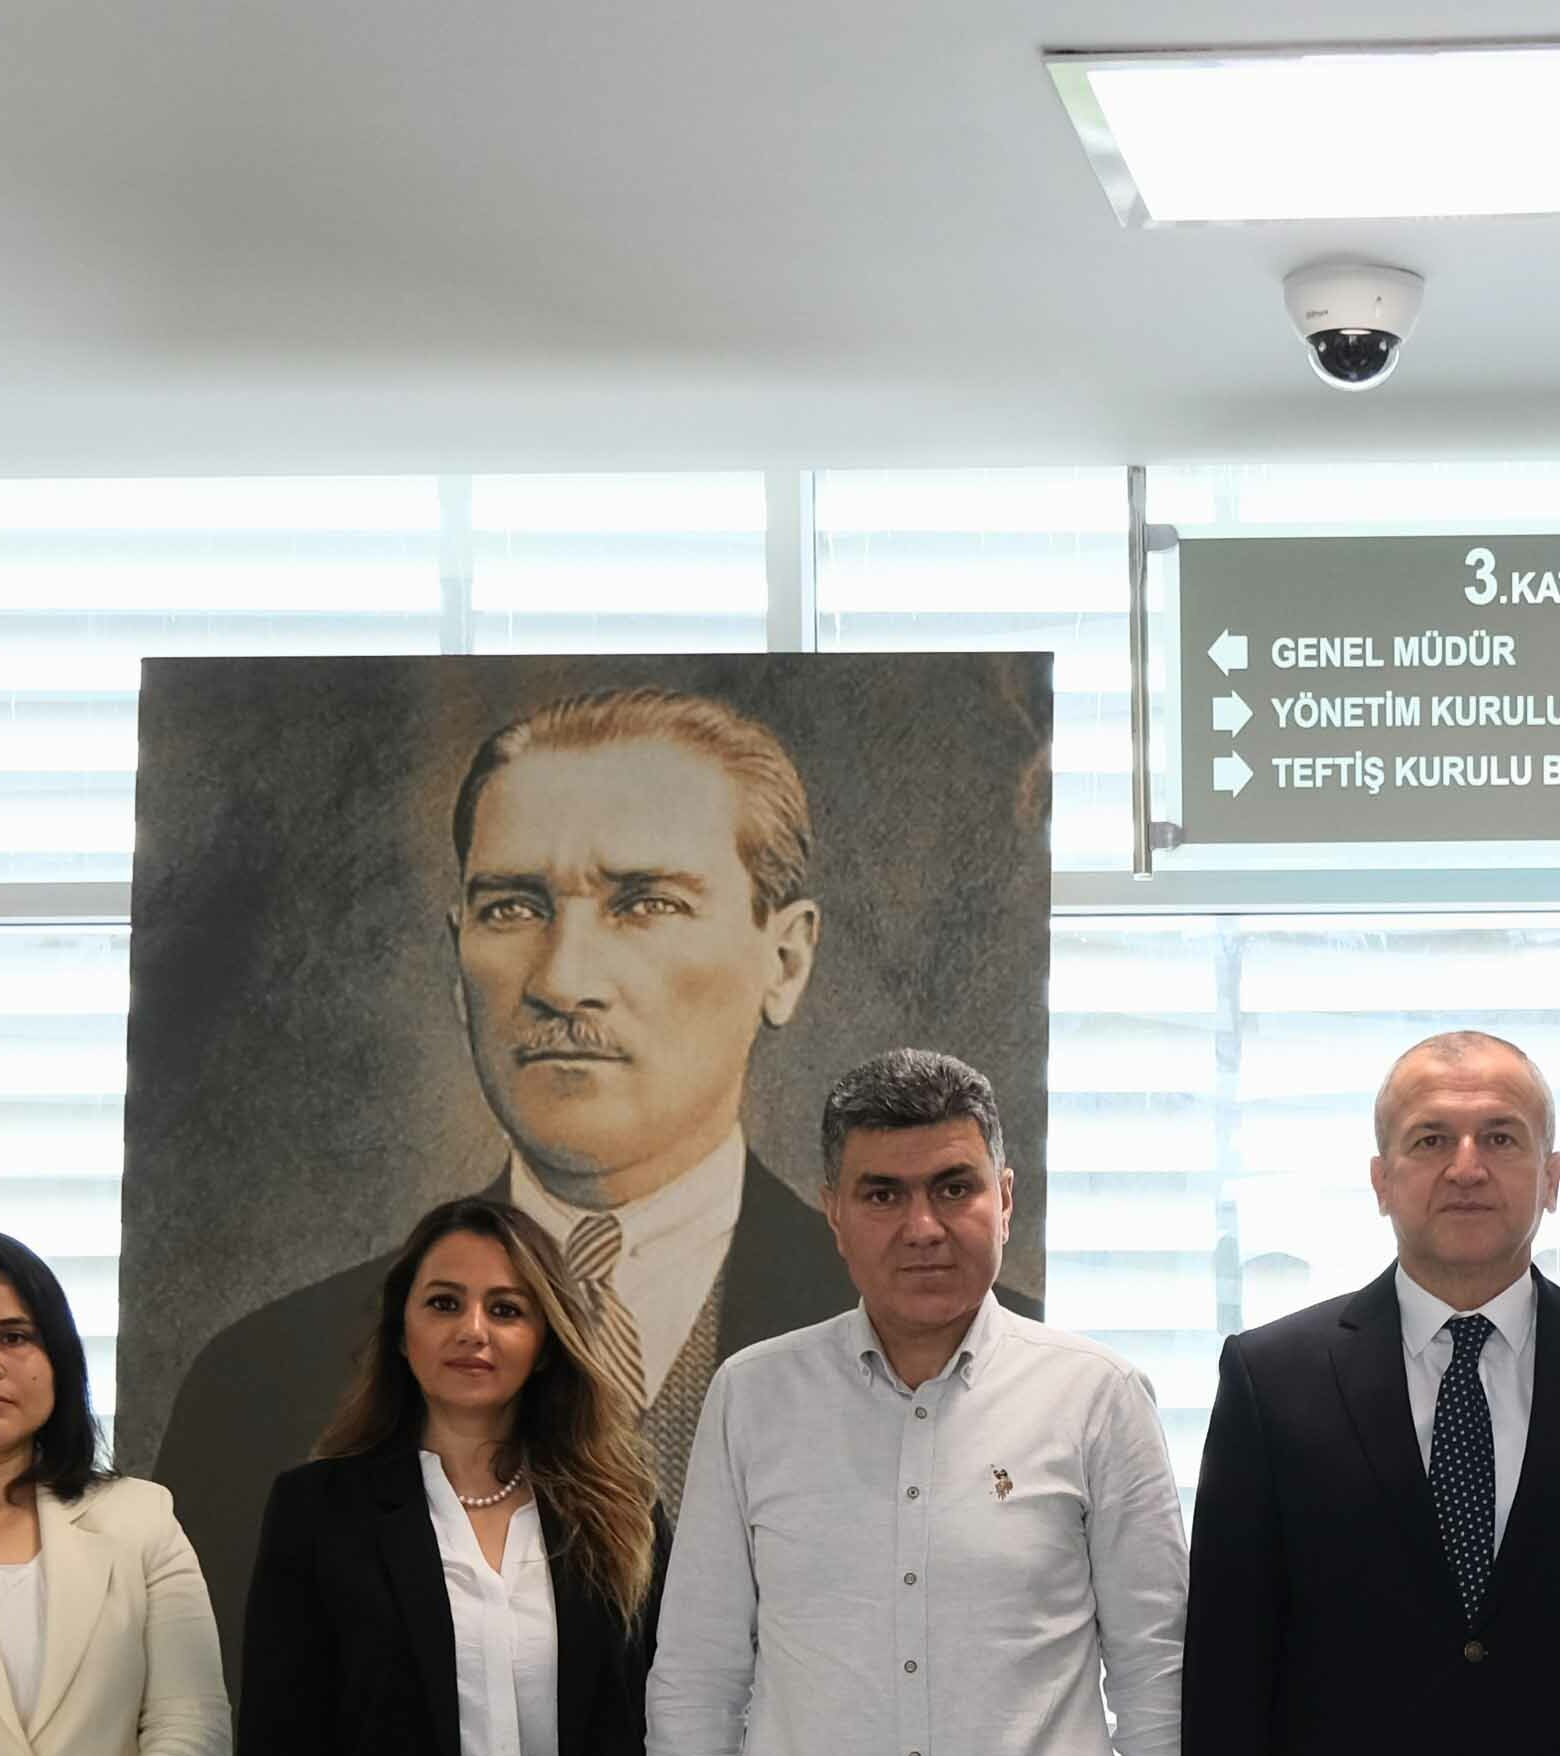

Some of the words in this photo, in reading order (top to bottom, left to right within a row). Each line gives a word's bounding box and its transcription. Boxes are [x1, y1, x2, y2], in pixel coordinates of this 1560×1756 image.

[1271, 636, 1385, 669] GENEL
[1393, 629, 1517, 667] MÜDÜR
[1270, 689, 1421, 729] YÖNETİM
[1271, 749, 1385, 795] TEFTİŞ
[1394, 754, 1533, 787] KURULU
